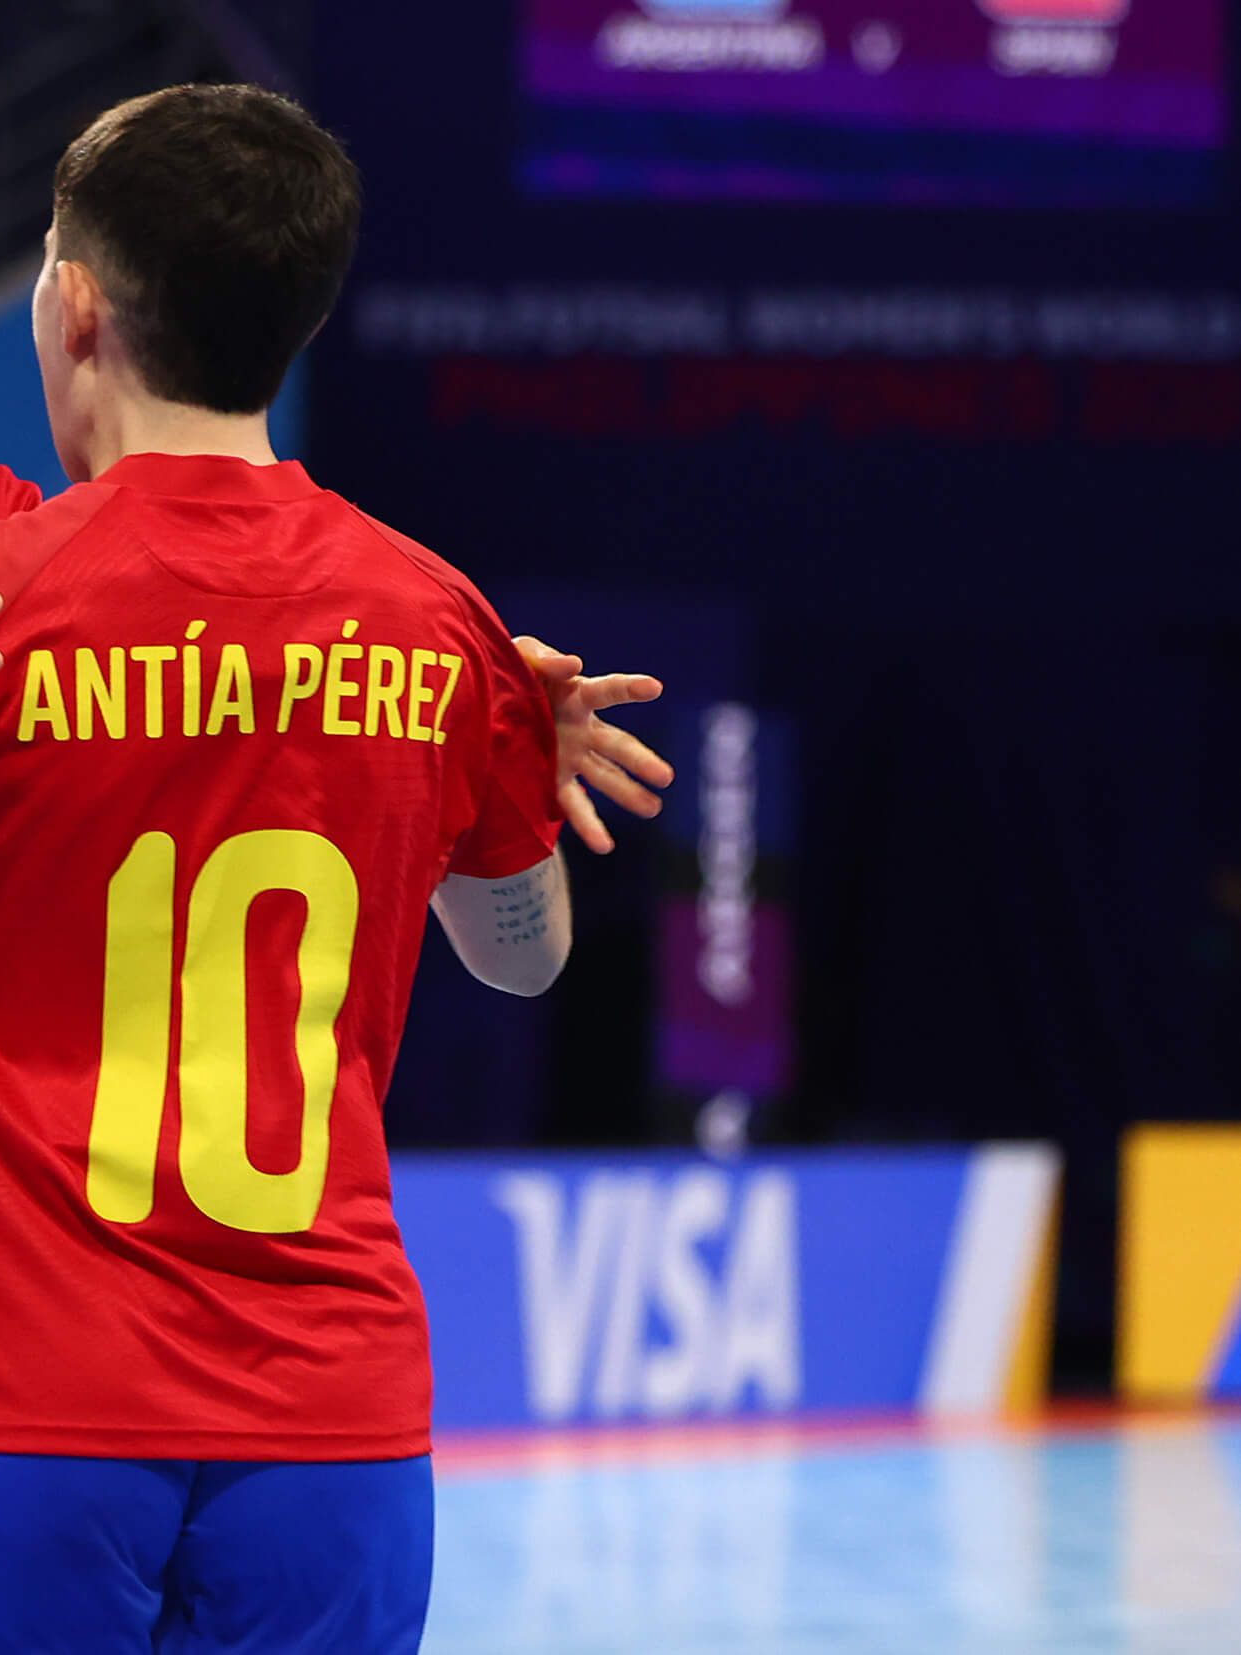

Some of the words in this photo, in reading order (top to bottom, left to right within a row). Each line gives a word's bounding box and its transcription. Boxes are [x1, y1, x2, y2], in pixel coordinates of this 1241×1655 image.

[17, 620, 256, 742] ANTÍA
[276, 620, 464, 745] PÉREZ
[86, 829, 359, 1234] 10
[499, 1172, 802, 1420] VISA
